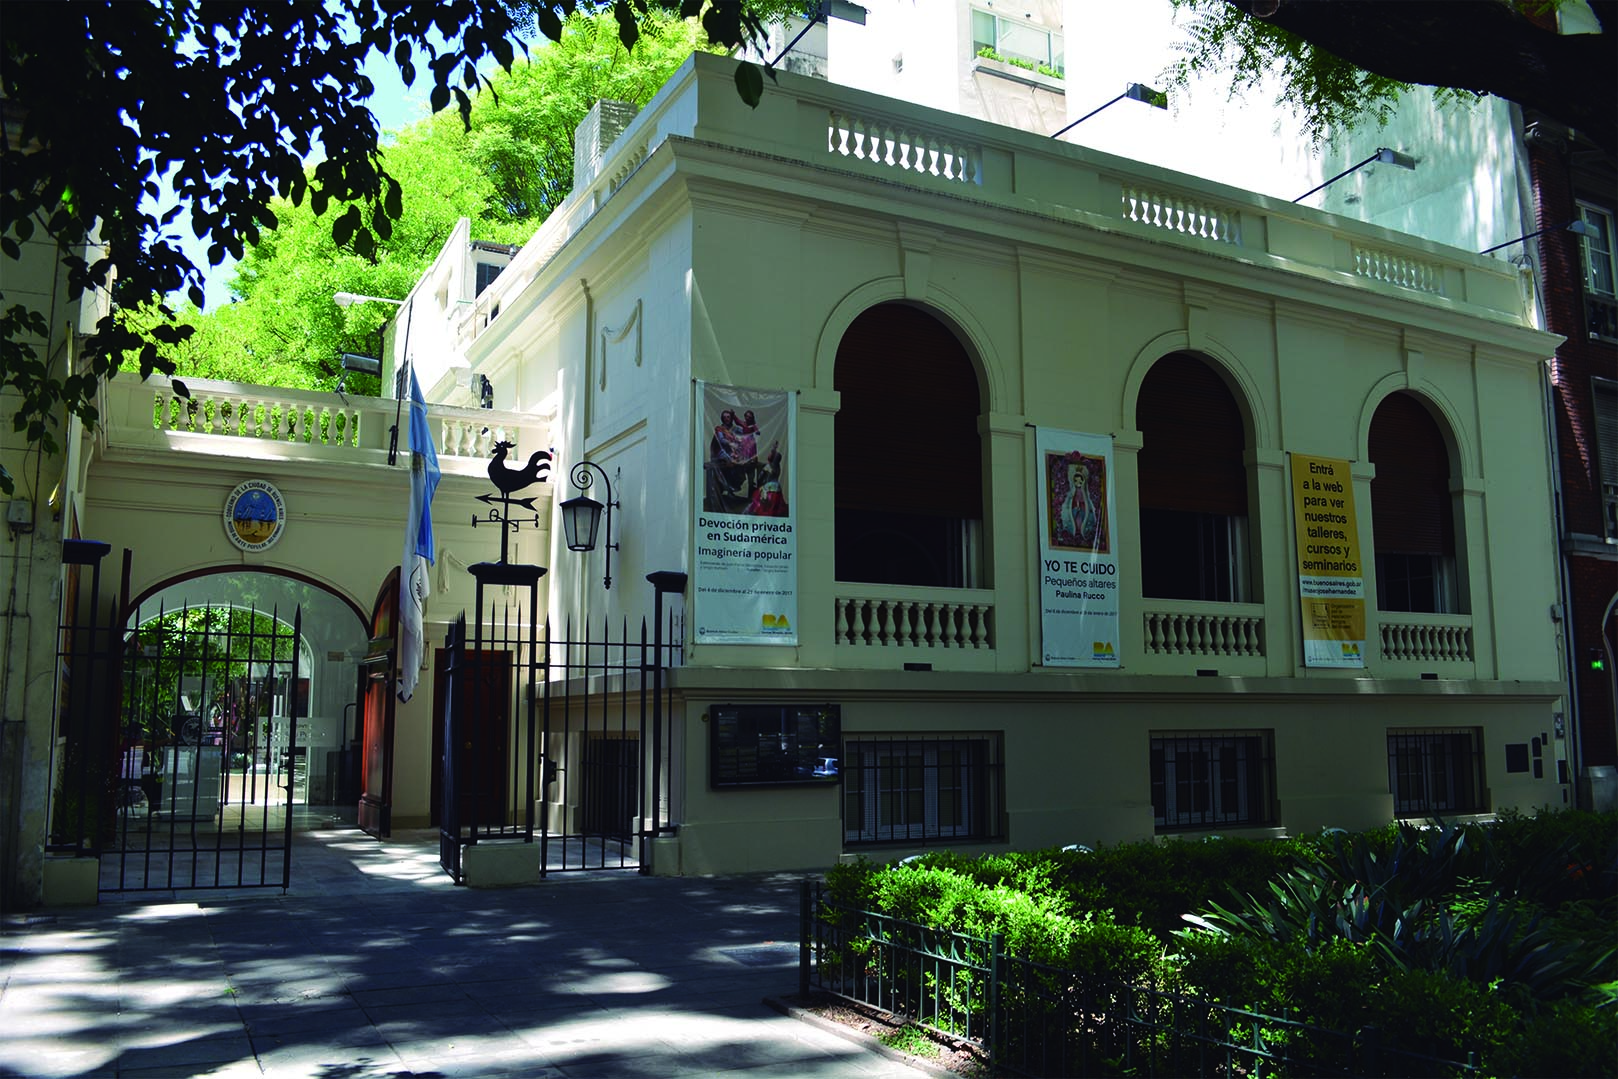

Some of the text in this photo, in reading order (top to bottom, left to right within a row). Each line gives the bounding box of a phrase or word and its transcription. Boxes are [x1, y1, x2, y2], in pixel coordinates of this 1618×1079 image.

[1309, 462, 1334, 475] Entrá
[1303, 479, 1344, 493] a la web
[1303, 496, 1345, 508] para ver
[1305, 512, 1347, 524] nuestros
[699, 517, 793, 533] Devoción privada
[707, 532, 788, 545] en Sudamérica
[1307, 526, 1347, 541] talleres,
[698, 546, 793, 561] Imaginería popular
[1306, 544, 1350, 558] cursos y
[1045, 560, 1115, 575] YO TE CUIDO
[1303, 559, 1357, 571] seminarios
[1045, 576, 1117, 589] Pequeños altares
[1056, 590, 1081, 599] Paulina
